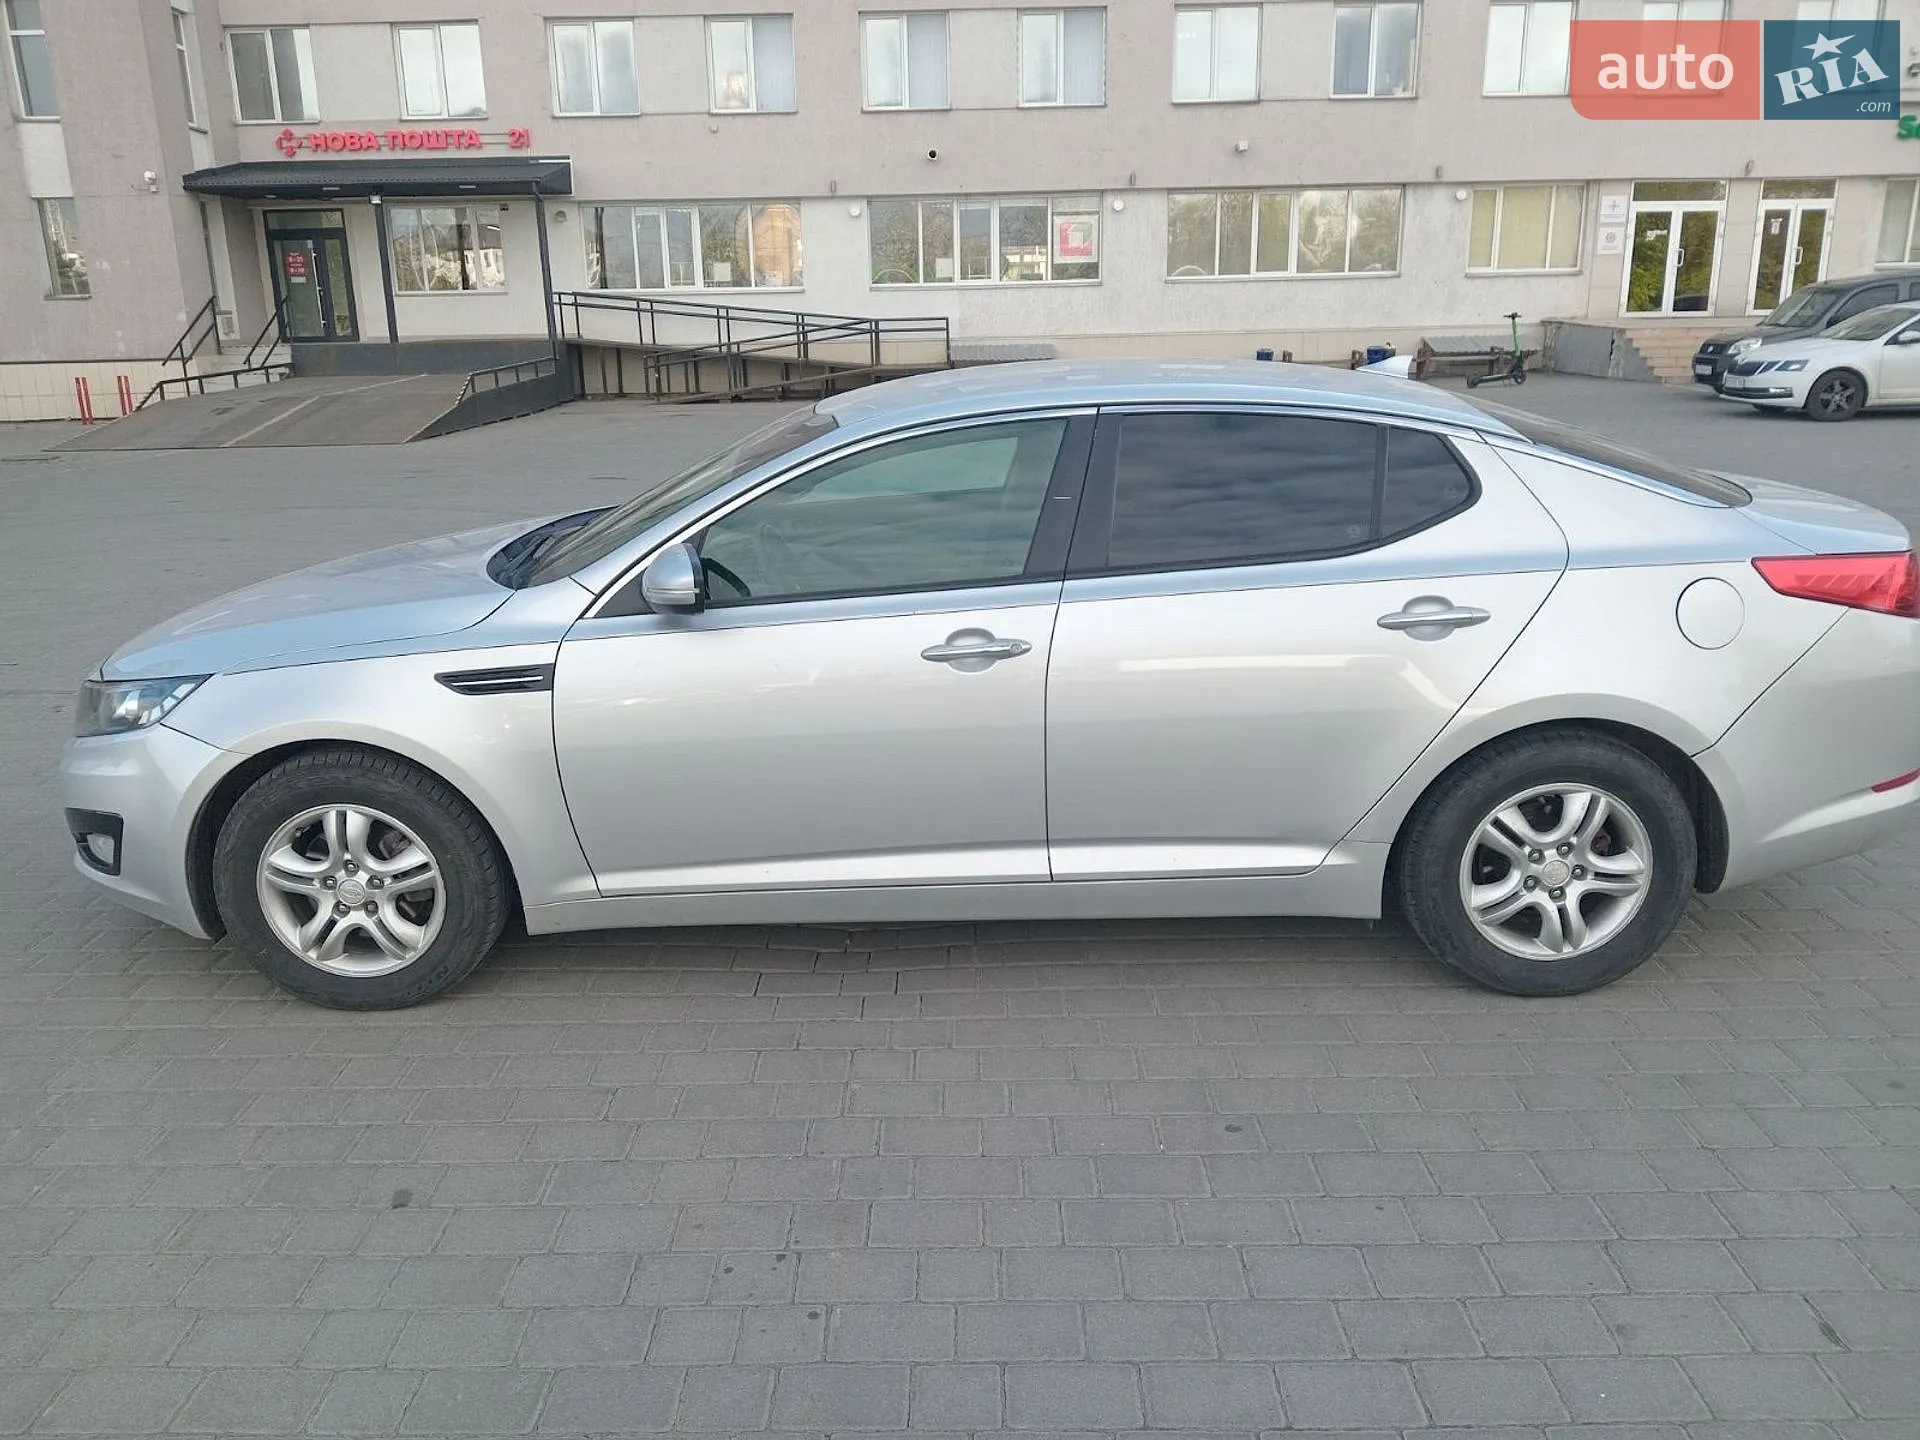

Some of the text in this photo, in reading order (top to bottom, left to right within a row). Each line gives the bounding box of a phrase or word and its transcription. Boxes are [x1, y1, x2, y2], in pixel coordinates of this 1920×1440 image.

[307, 128, 530, 152] НОВА ПОШТА 21
